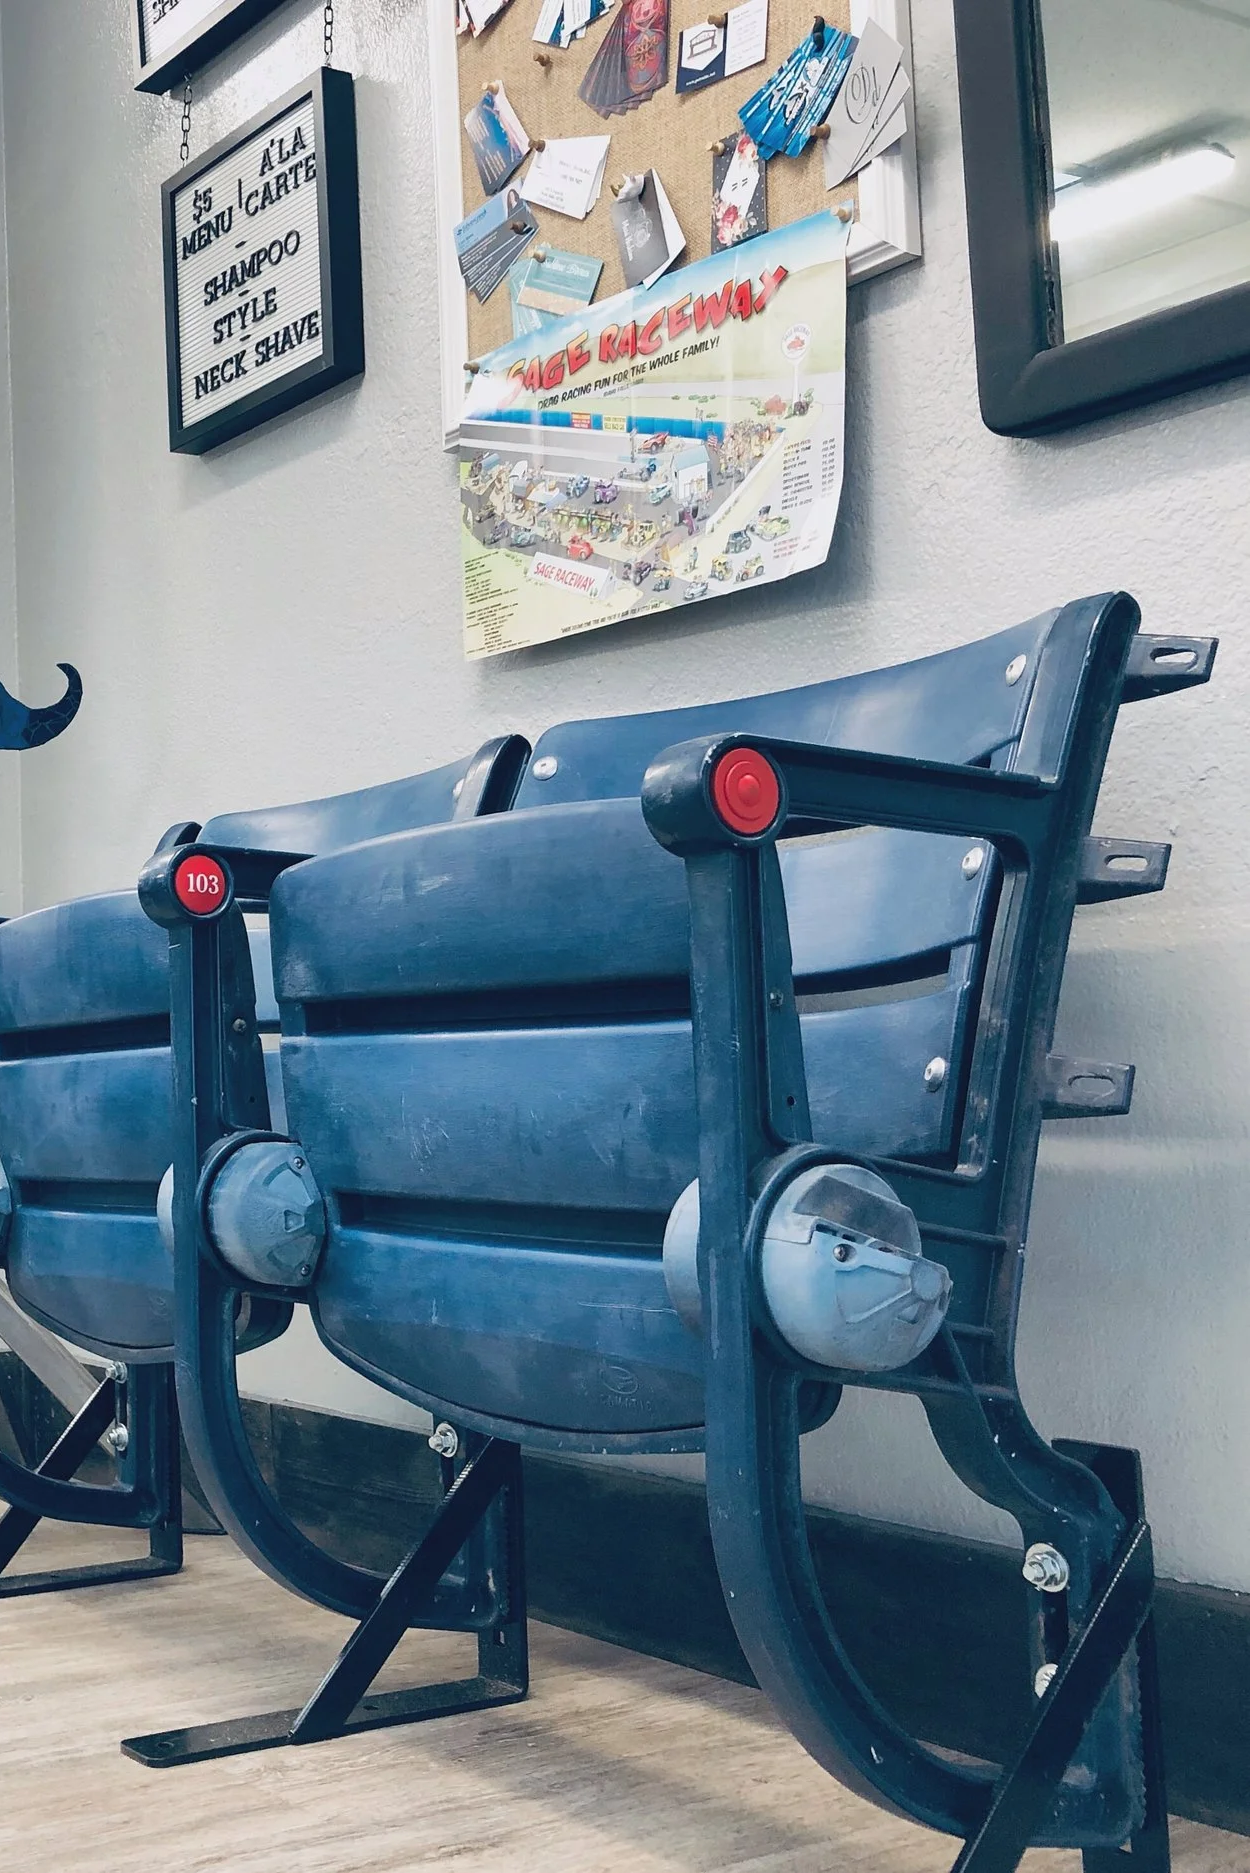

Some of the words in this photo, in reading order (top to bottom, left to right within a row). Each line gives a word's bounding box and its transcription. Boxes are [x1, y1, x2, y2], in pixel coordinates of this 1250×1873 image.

[191, 188, 212, 221] $5
[244, 154, 318, 216] CARTE
[181, 206, 233, 260] MENU
[203, 230, 301, 306] SHAMPOO
[213, 287, 278, 345] STYLE
[500, 329, 591, 407] SAGE
[598, 265, 789, 364] RACEWAY
[194, 350, 247, 400] NECK
[254, 311, 319, 366] SHAVE
[538, 396, 559, 410] DRAG
[561, 384, 592, 402] RACING
[594, 376, 610, 391] FUN
[612, 369, 629, 385] FOR
[630, 364, 647, 379] THE
[649, 350, 680, 371] WHOLE
[682, 336, 720, 359] FAMILY!
[534, 562, 554, 580] SAGE
[555, 569, 595, 592] RACEWAY
[187, 873, 219, 895] 103
